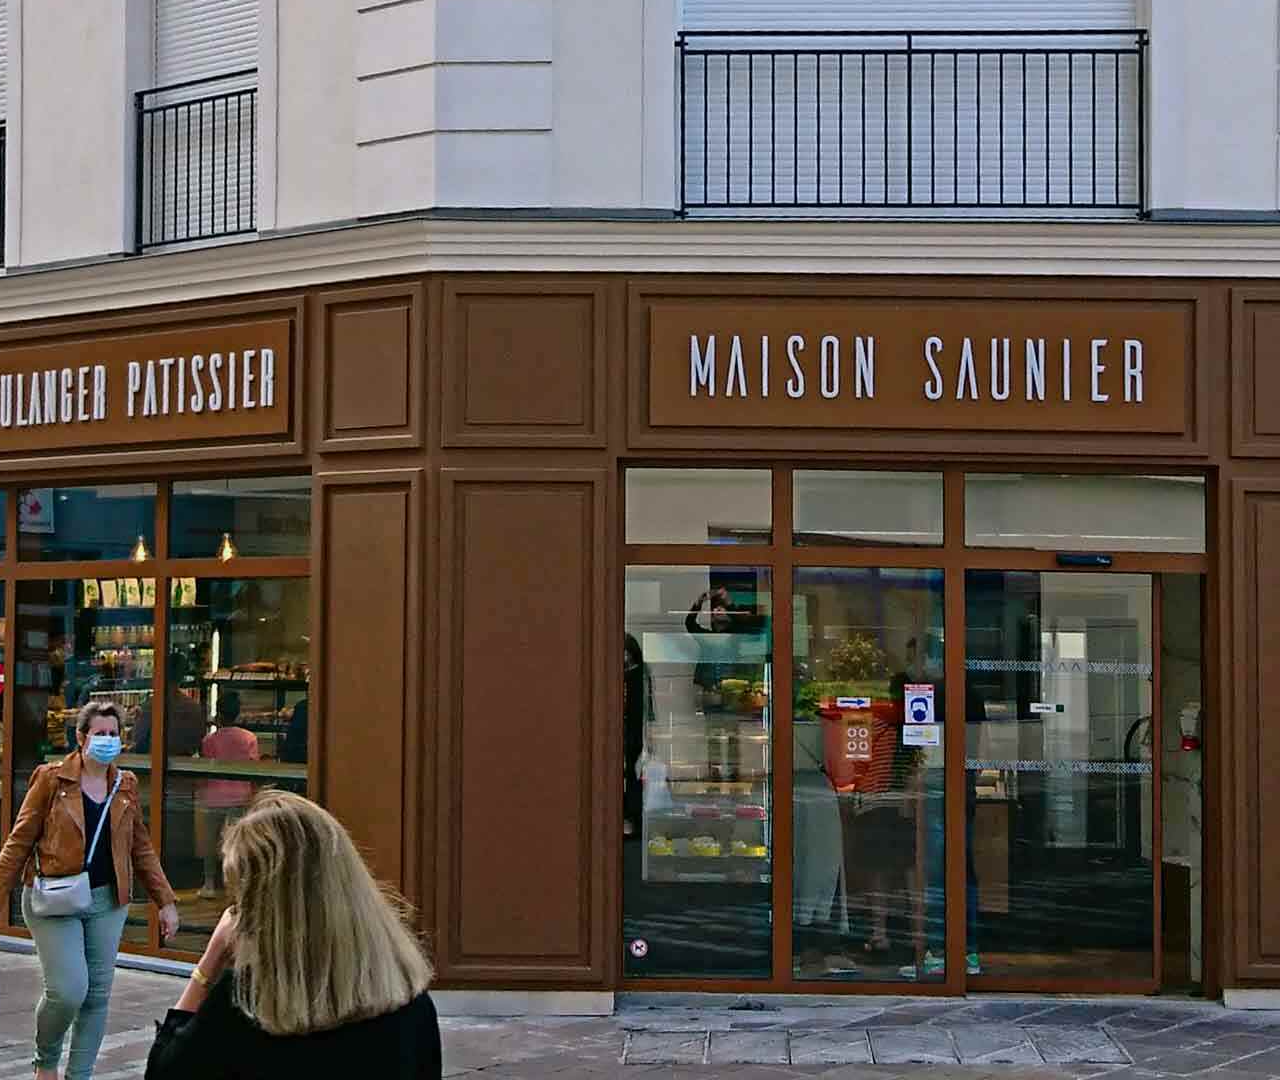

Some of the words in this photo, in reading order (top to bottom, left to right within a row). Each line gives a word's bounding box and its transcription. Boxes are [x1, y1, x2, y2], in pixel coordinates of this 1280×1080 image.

[126, 348, 275, 417] PATISSIER
[689, 334, 875, 398] MAISON
[924, 336, 1144, 403] SAUNIER
